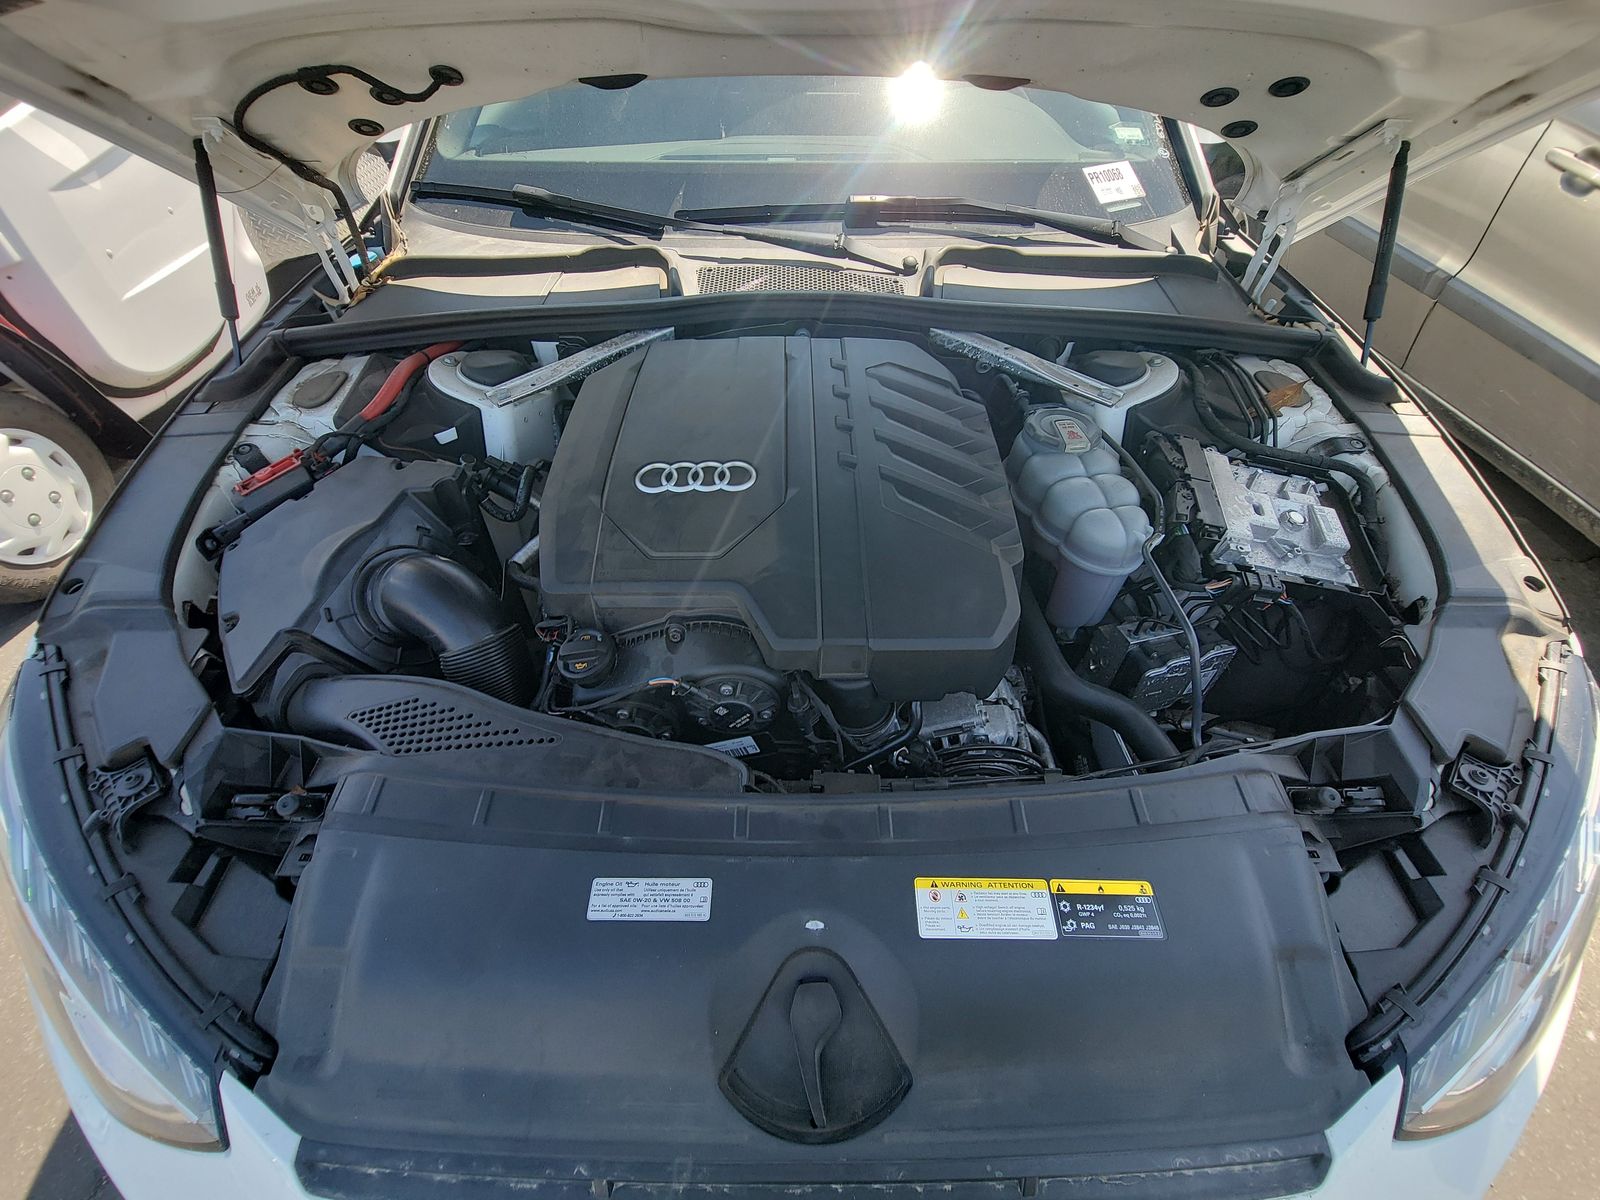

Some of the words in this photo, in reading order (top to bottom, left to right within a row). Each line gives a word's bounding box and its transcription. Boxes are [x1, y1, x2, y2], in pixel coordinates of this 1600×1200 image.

[1087, 168, 1124, 185] PR10068
[1076, 904, 1104, 912] R-1234yf
[1136, 905, 1145, 913] kg
